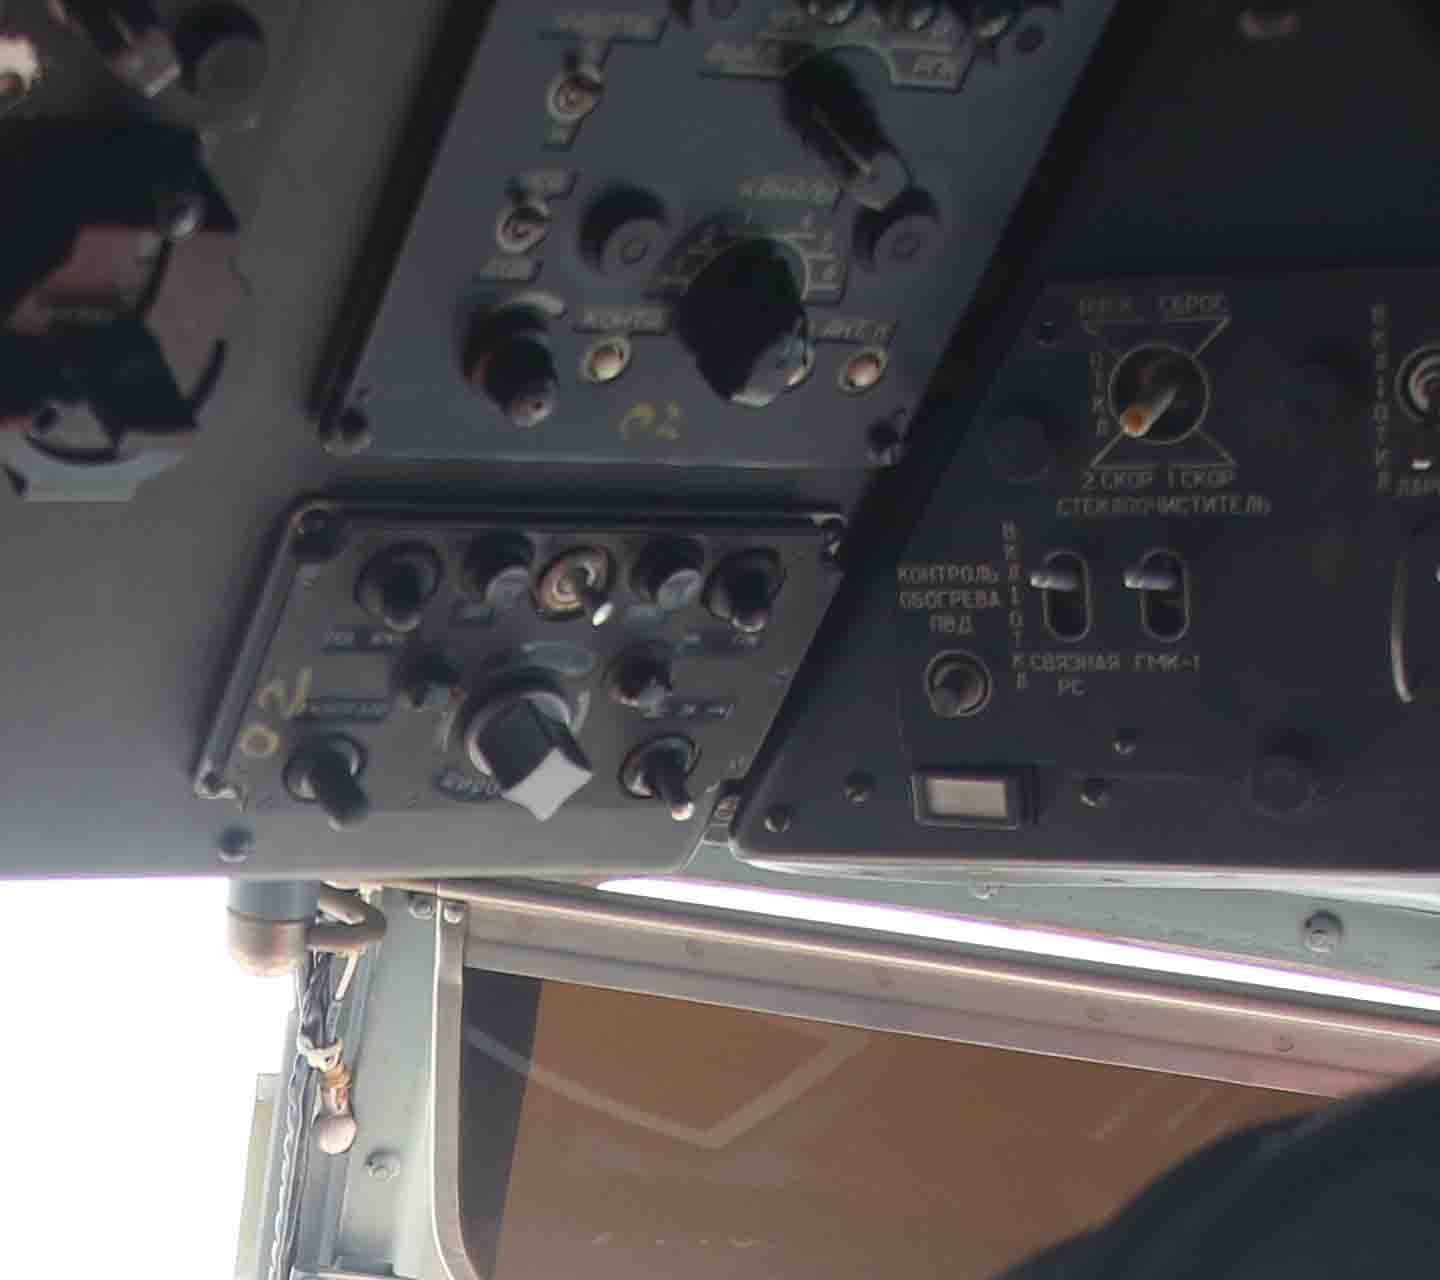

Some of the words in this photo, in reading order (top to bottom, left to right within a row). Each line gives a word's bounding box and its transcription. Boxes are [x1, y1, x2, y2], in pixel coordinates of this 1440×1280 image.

[896, 563, 1001, 585] КОНТРОЛЬ
[897, 589, 1002, 610] ОБОГРЕВА
[927, 614, 976, 636] ПВД
